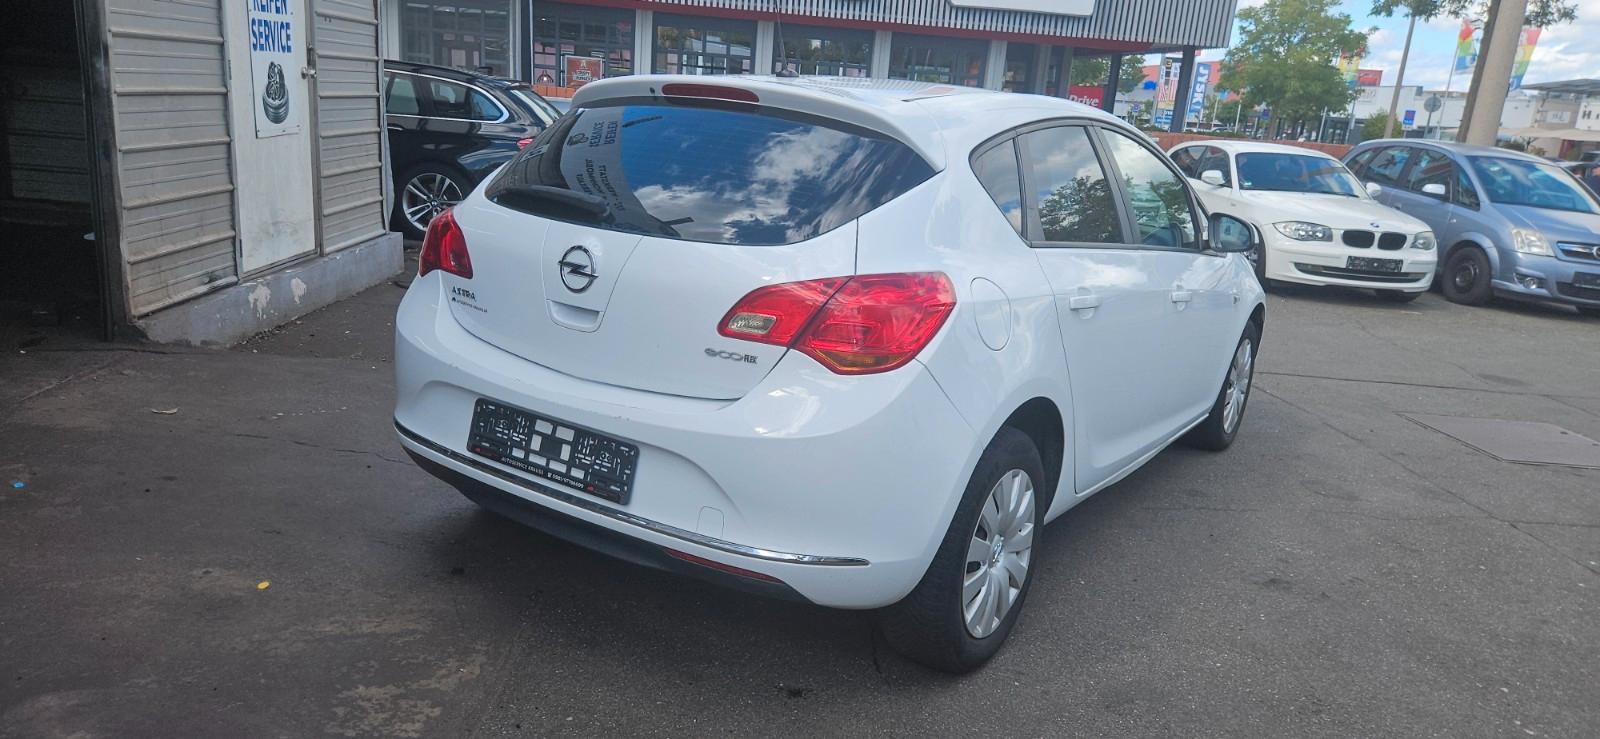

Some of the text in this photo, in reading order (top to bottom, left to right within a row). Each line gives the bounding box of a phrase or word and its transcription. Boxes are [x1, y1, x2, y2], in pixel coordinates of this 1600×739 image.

[251, 17, 292, 53] SERVICE
[1069, 95, 1100, 107] Drive
[452, 286, 477, 302] ASTRA
